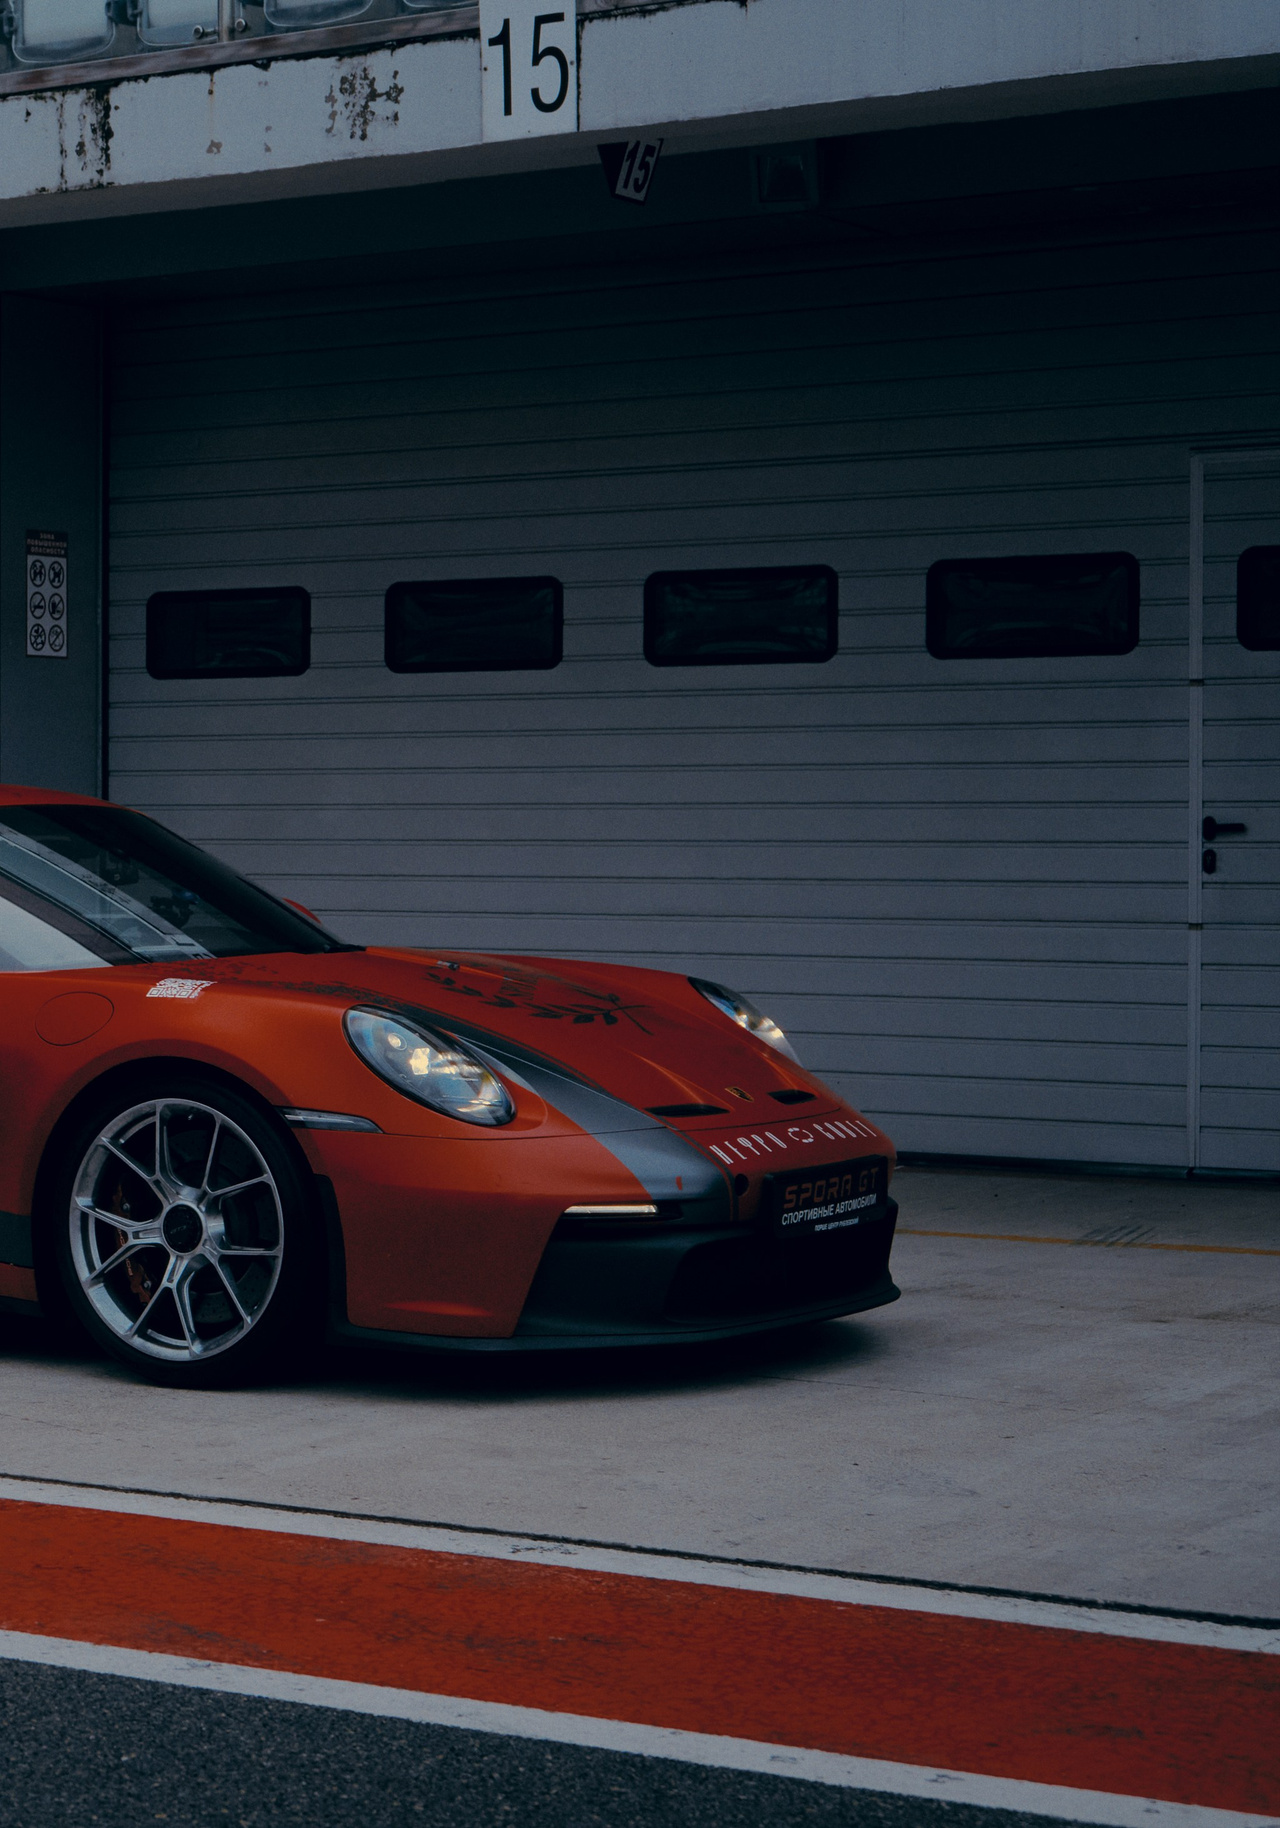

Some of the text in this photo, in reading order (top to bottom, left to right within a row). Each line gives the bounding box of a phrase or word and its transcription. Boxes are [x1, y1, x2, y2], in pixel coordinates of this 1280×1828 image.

[487, 12, 569, 116] 15
[622, 140, 657, 194] 15
[709, 1131, 788, 1165] НЕФРО
[783, 1167, 880, 1209] SPORA GT
[781, 1193, 877, 1226] СПОРТИВНЫЕ АВТОМОБИЛИ
